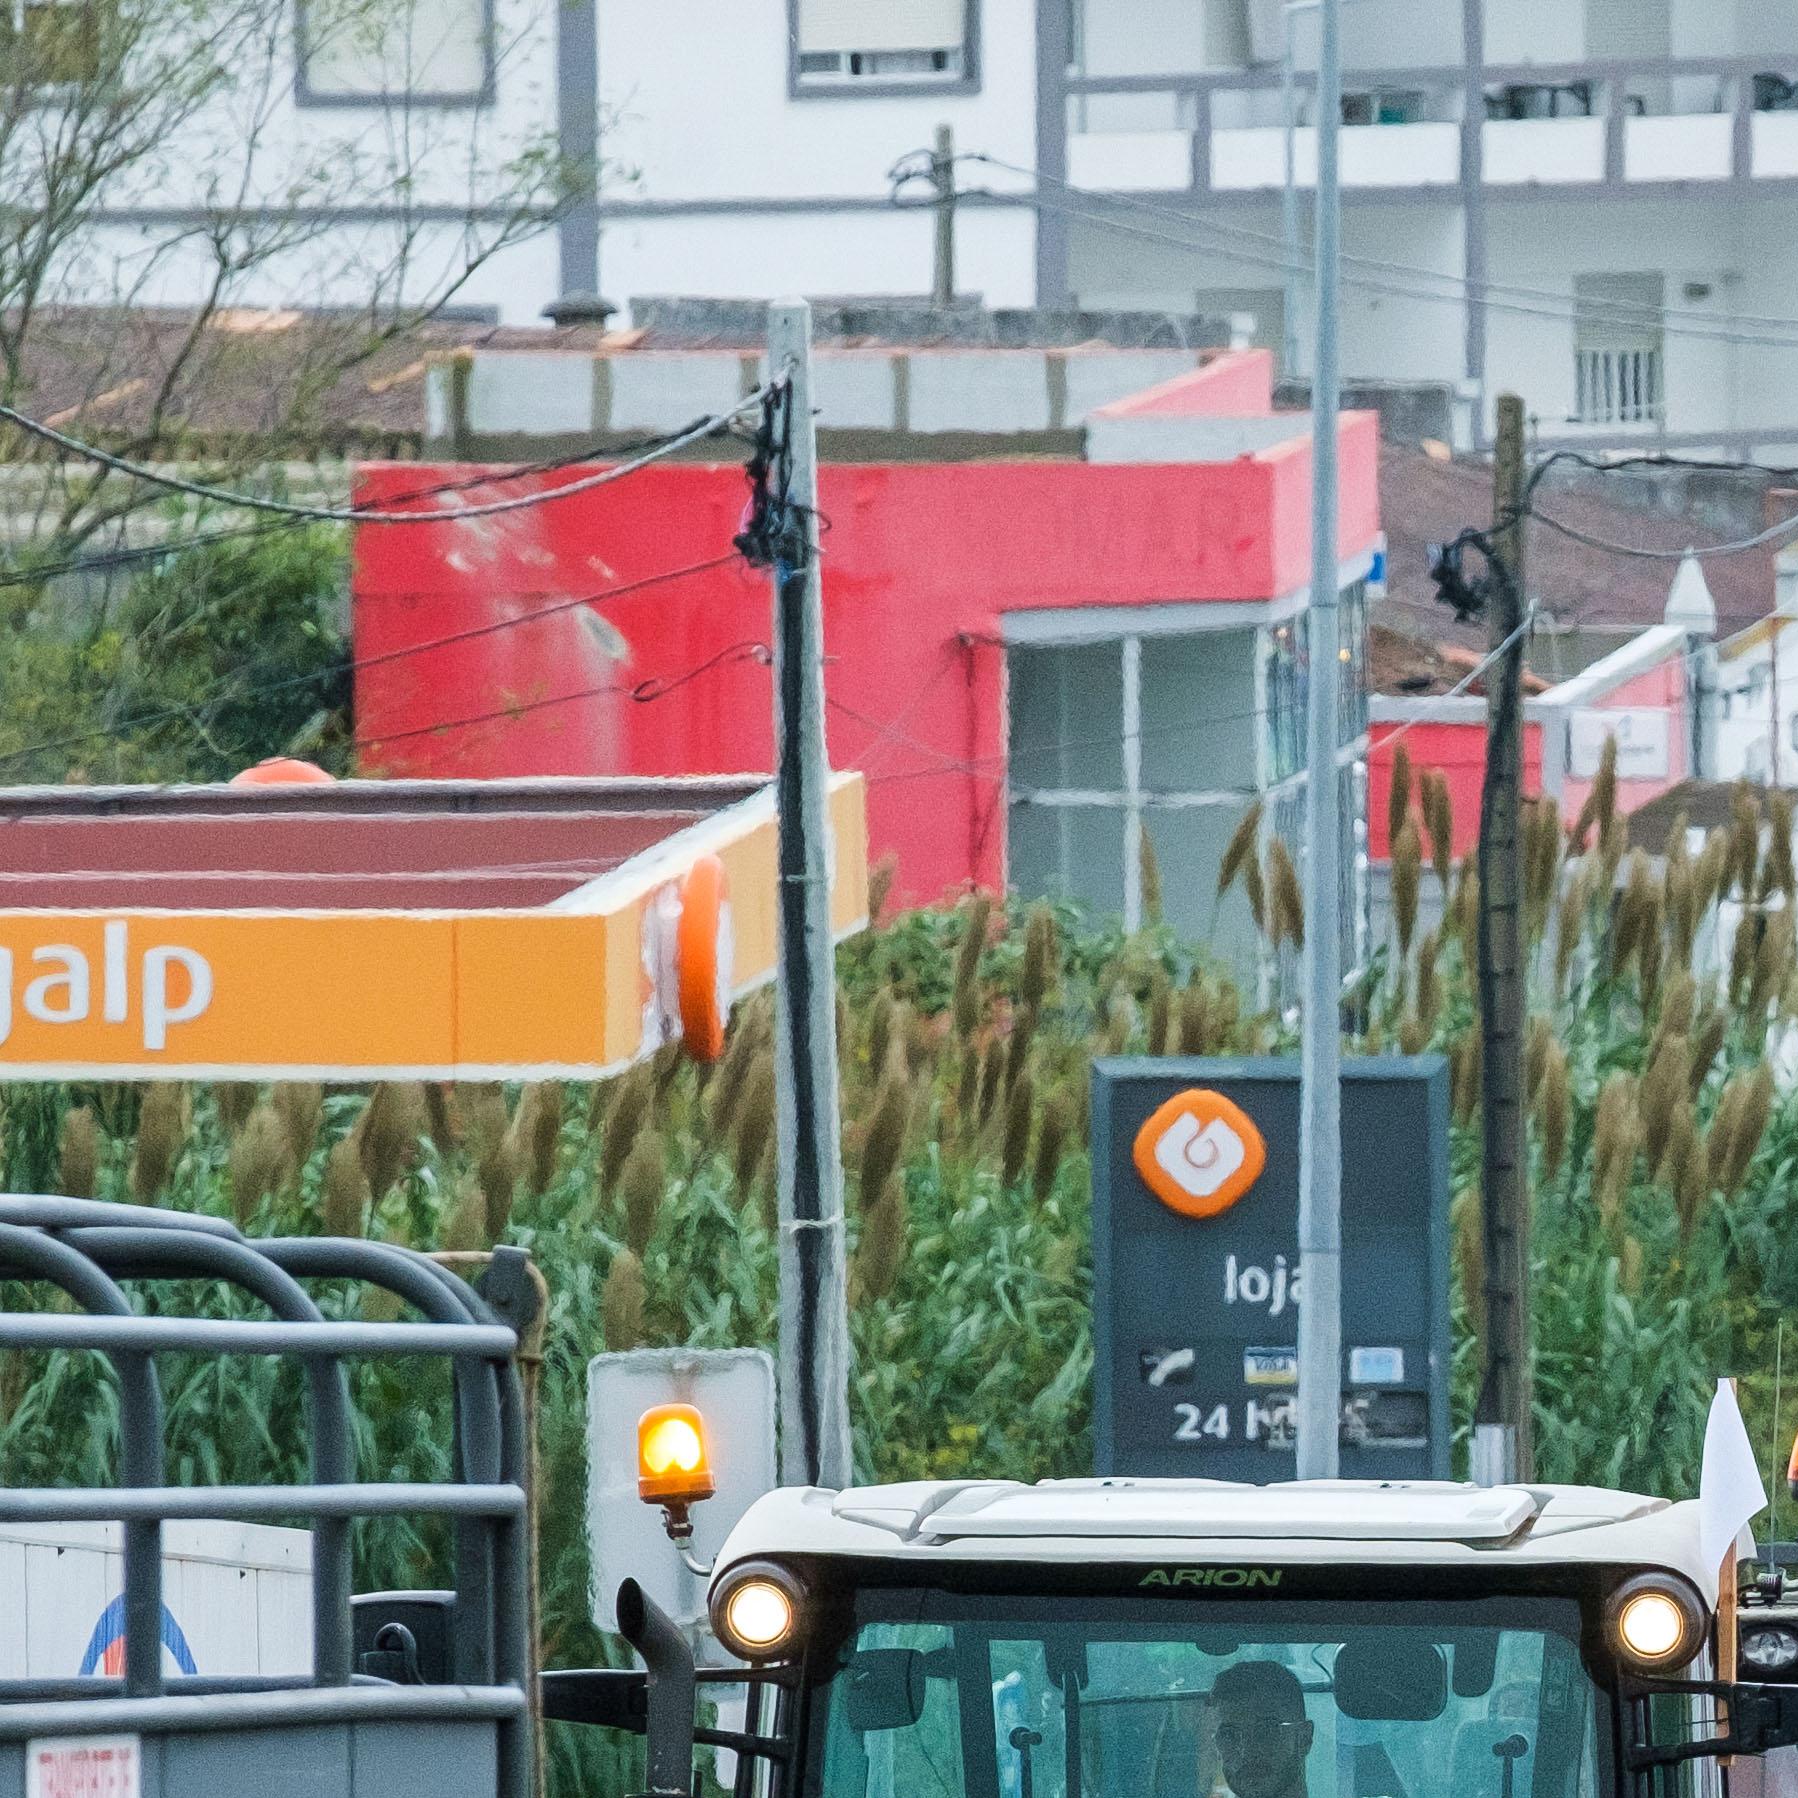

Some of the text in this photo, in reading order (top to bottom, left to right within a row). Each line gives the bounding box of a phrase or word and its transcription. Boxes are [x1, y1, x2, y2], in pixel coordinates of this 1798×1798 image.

[0, 921, 214, 1051] alp
[1174, 1402, 1230, 1440] 24
[1138, 1568, 1283, 1588] ARION
